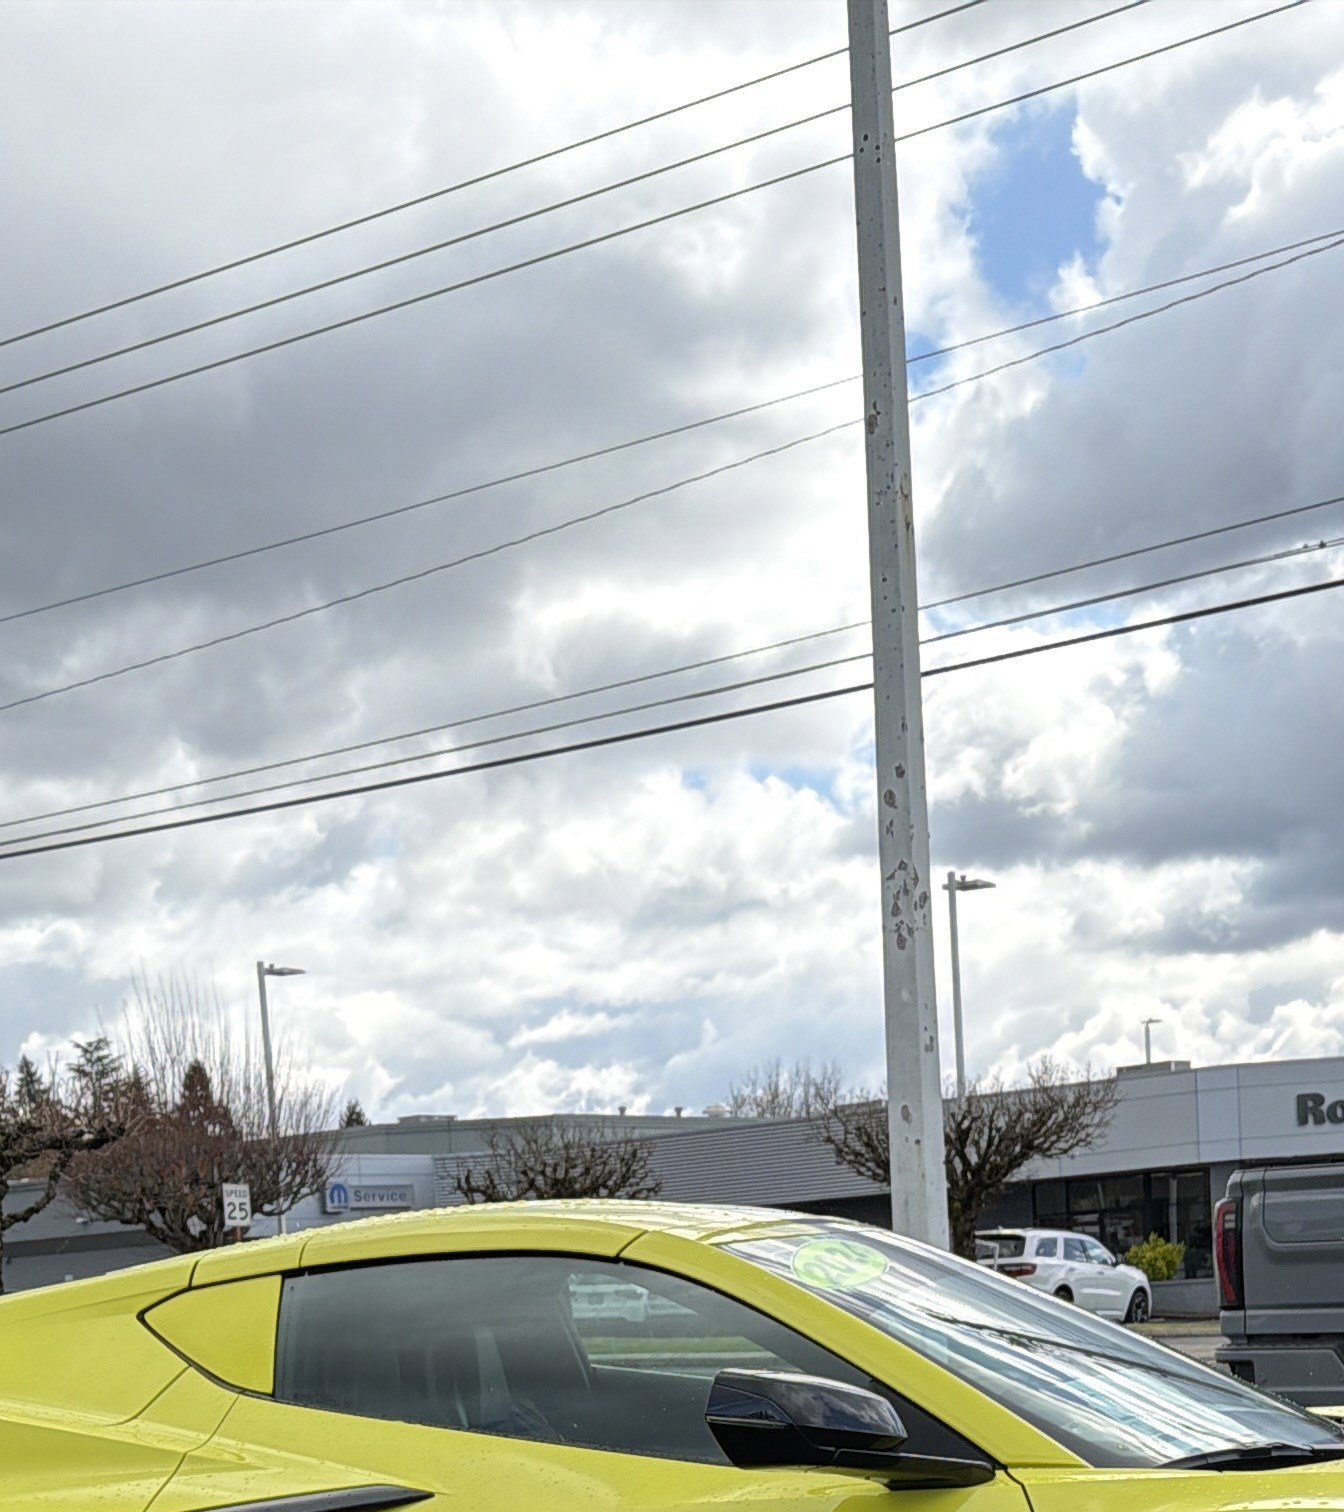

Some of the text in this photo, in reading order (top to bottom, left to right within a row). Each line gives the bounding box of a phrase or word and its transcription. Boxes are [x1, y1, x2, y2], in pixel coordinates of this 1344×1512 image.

[224, 1188, 248, 1199] SPEED
[354, 1188, 407, 1203] Service
[227, 1201, 249, 1221] 25
